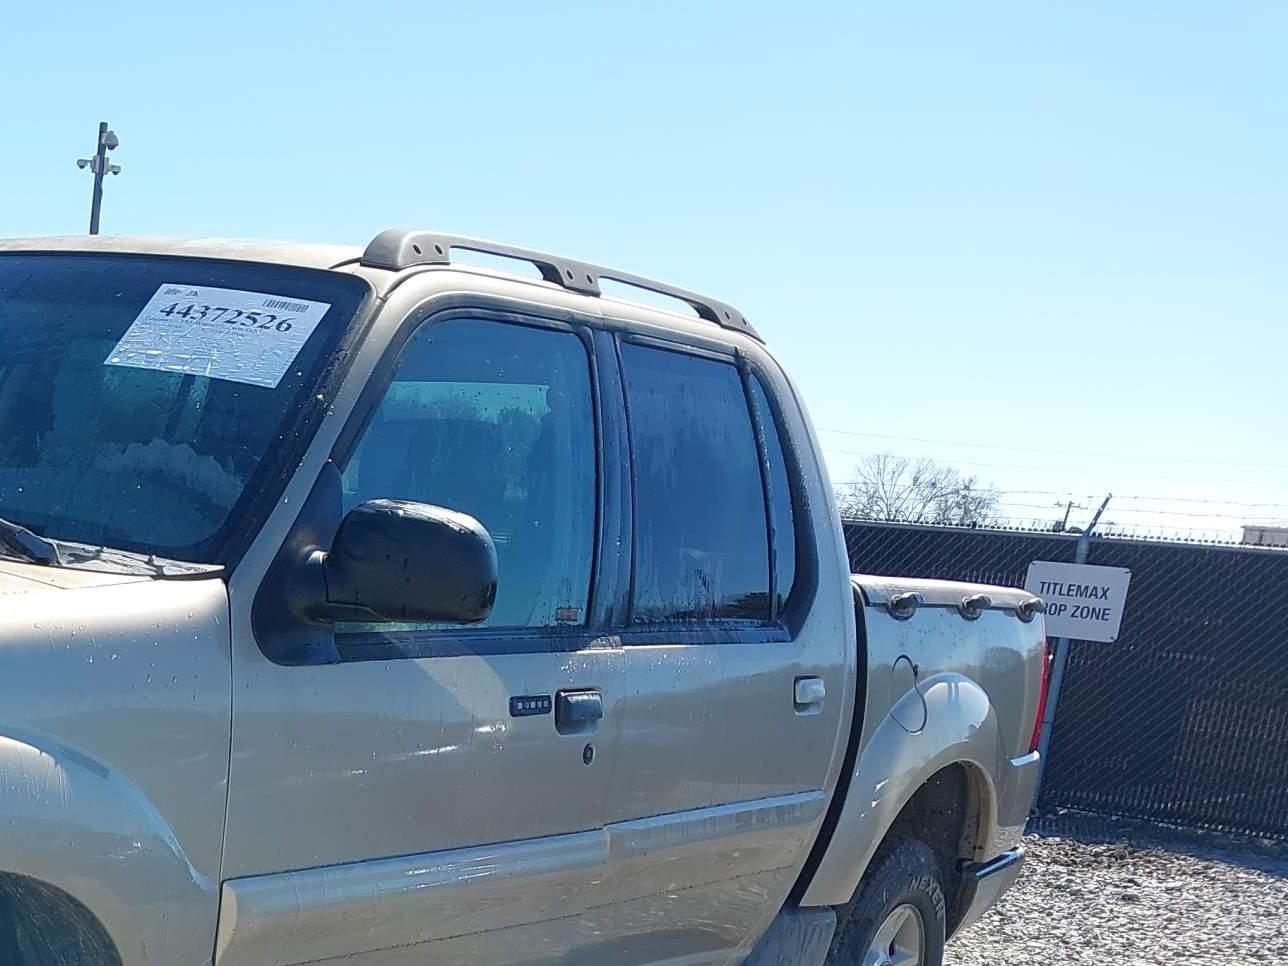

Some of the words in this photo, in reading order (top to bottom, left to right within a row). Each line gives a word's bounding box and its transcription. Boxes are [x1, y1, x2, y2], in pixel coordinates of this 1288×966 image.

[160, 302, 296, 332] 44372526
[1039, 581, 1110, 600] TITLEMAX
[1070, 605, 1111, 621] ZONE
[907, 875, 945, 920] NEXEN
